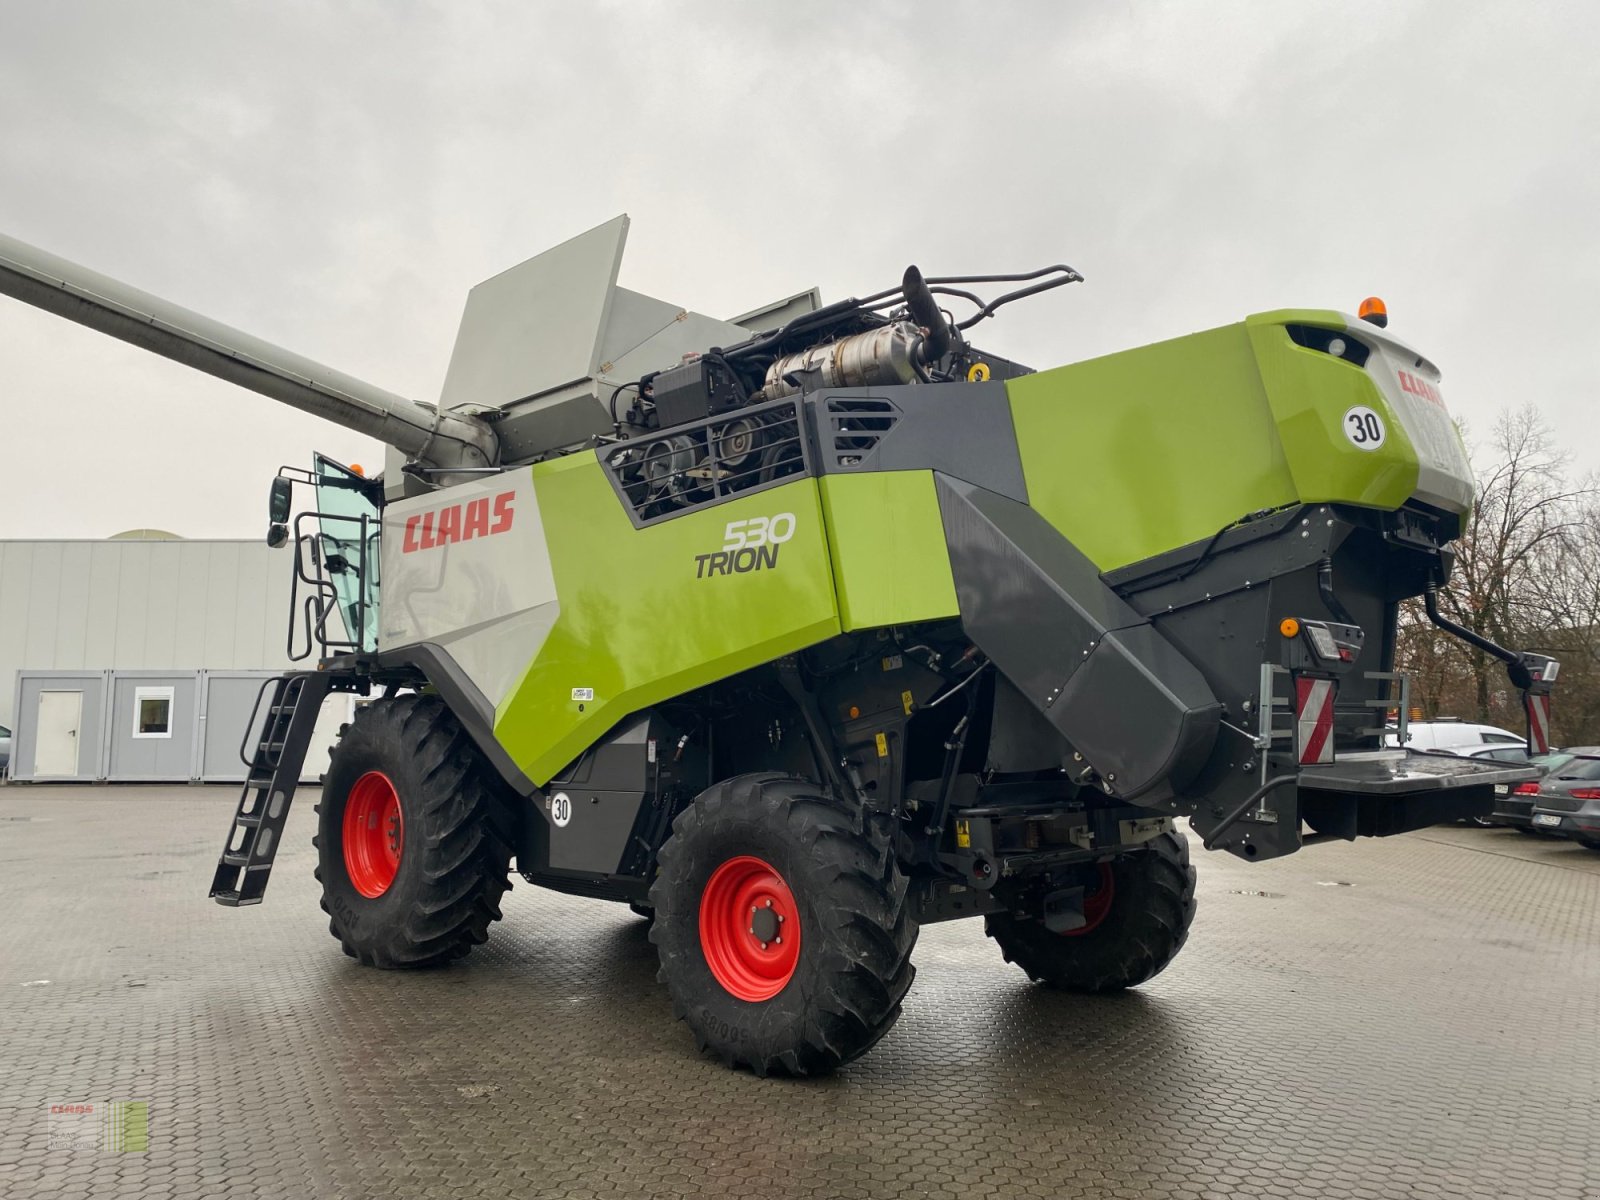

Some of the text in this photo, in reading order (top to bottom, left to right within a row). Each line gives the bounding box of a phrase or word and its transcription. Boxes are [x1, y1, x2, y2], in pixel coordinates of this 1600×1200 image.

[1348, 413, 1381, 443] 30
[402, 491, 516, 554] CLAAS
[723, 512, 796, 552] 530
[695, 543, 779, 579] TRION
[554, 799, 568, 820] 30
